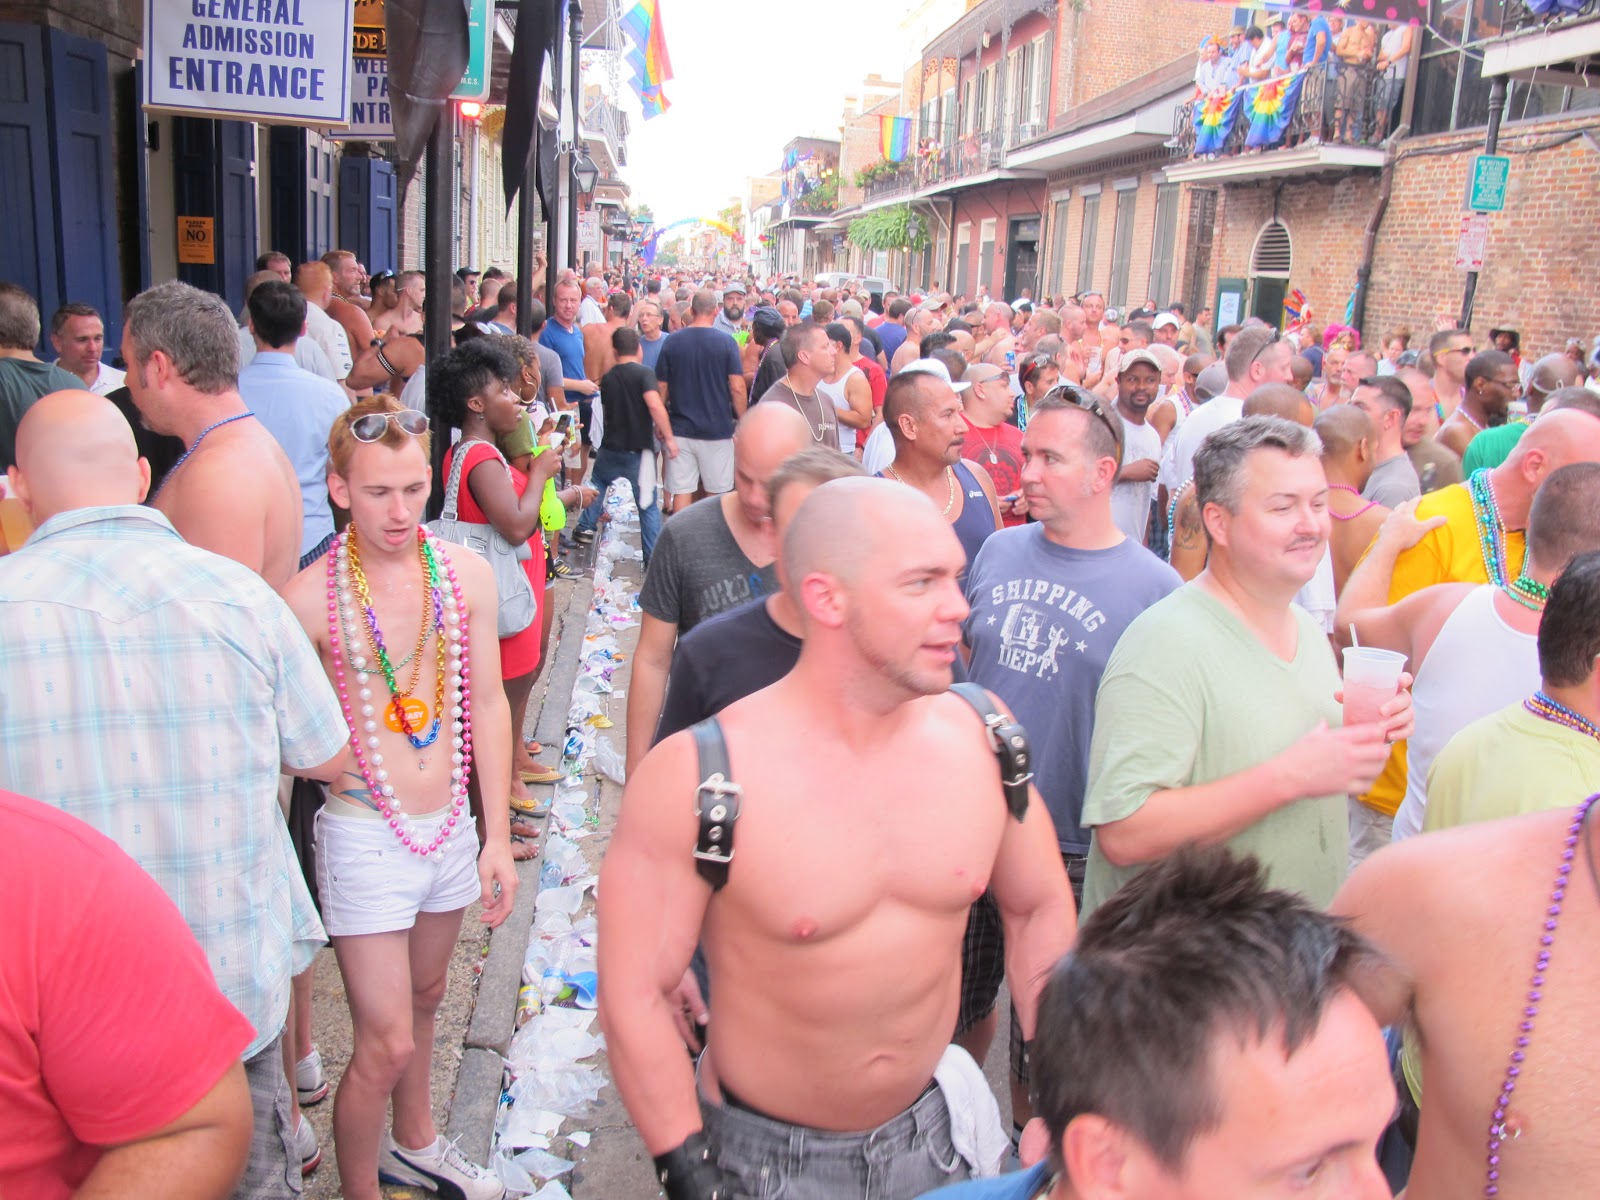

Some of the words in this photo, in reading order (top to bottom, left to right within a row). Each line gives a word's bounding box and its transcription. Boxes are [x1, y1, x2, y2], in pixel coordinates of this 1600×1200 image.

[192, 0, 304, 26] GENERAL
[182, 23, 315, 60] ADMISSION
[168, 56, 326, 102] ENTRANCE
[186, 229, 206, 242] NO
[991, 578, 1107, 634] SHIPPING
